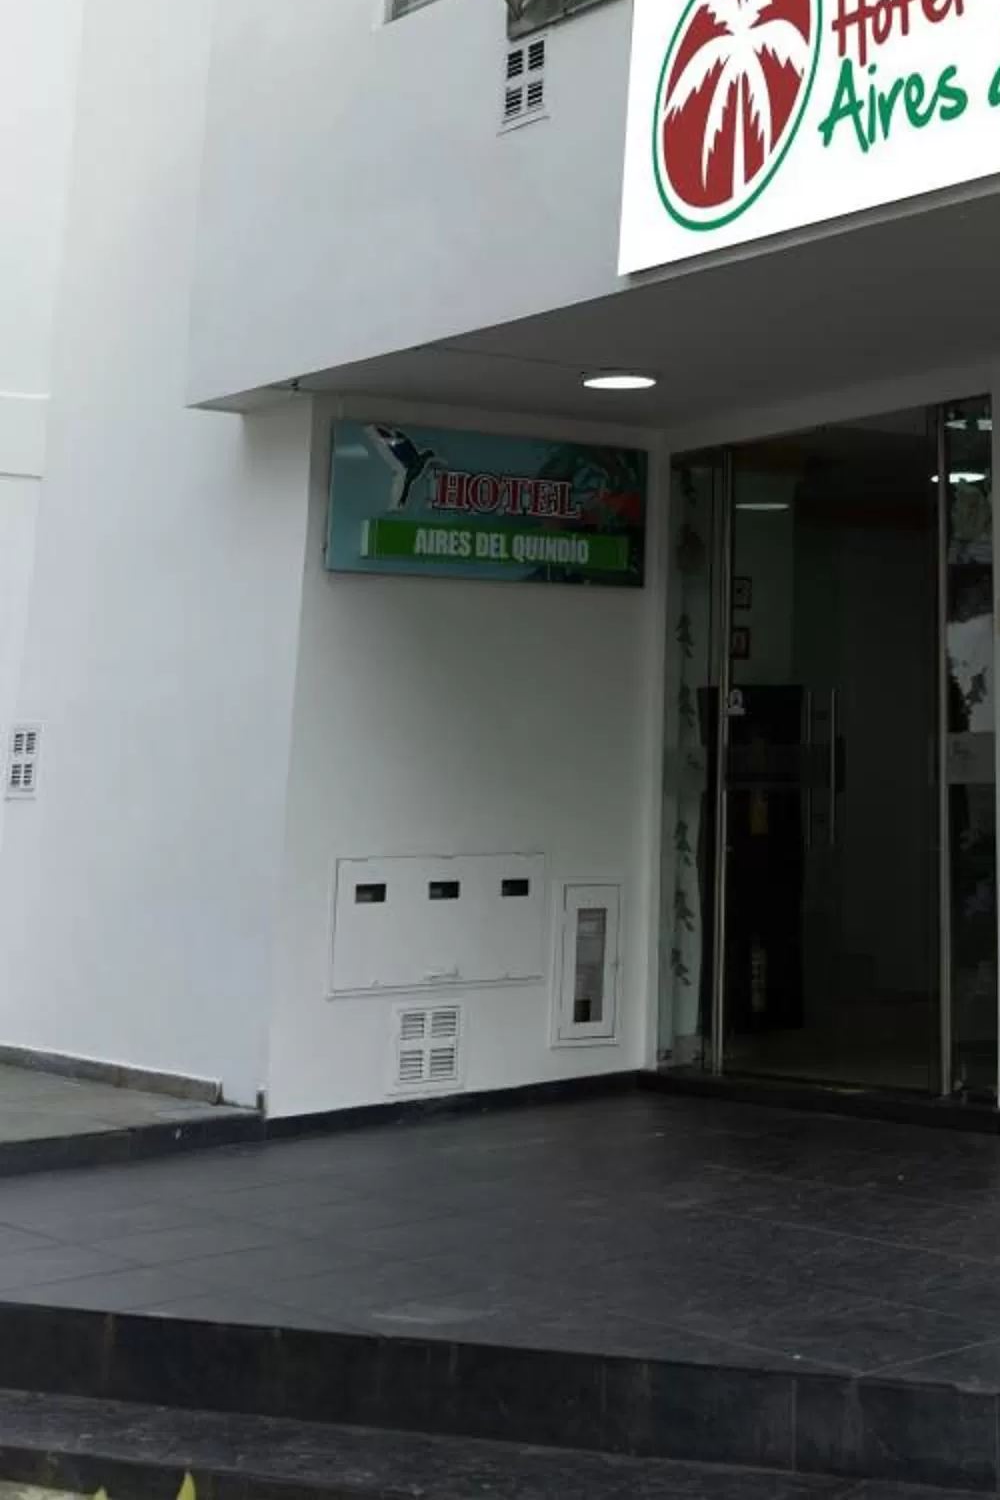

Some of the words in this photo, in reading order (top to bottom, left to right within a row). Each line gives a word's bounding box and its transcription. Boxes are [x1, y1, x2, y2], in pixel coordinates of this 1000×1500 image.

[817, 57, 968, 154] Aires
[429, 470, 582, 520] HOTEL
[414, 527, 472, 558] AIRES
[476, 533, 509, 560] DEL
[514, 534, 590, 565] QUINDÍO
